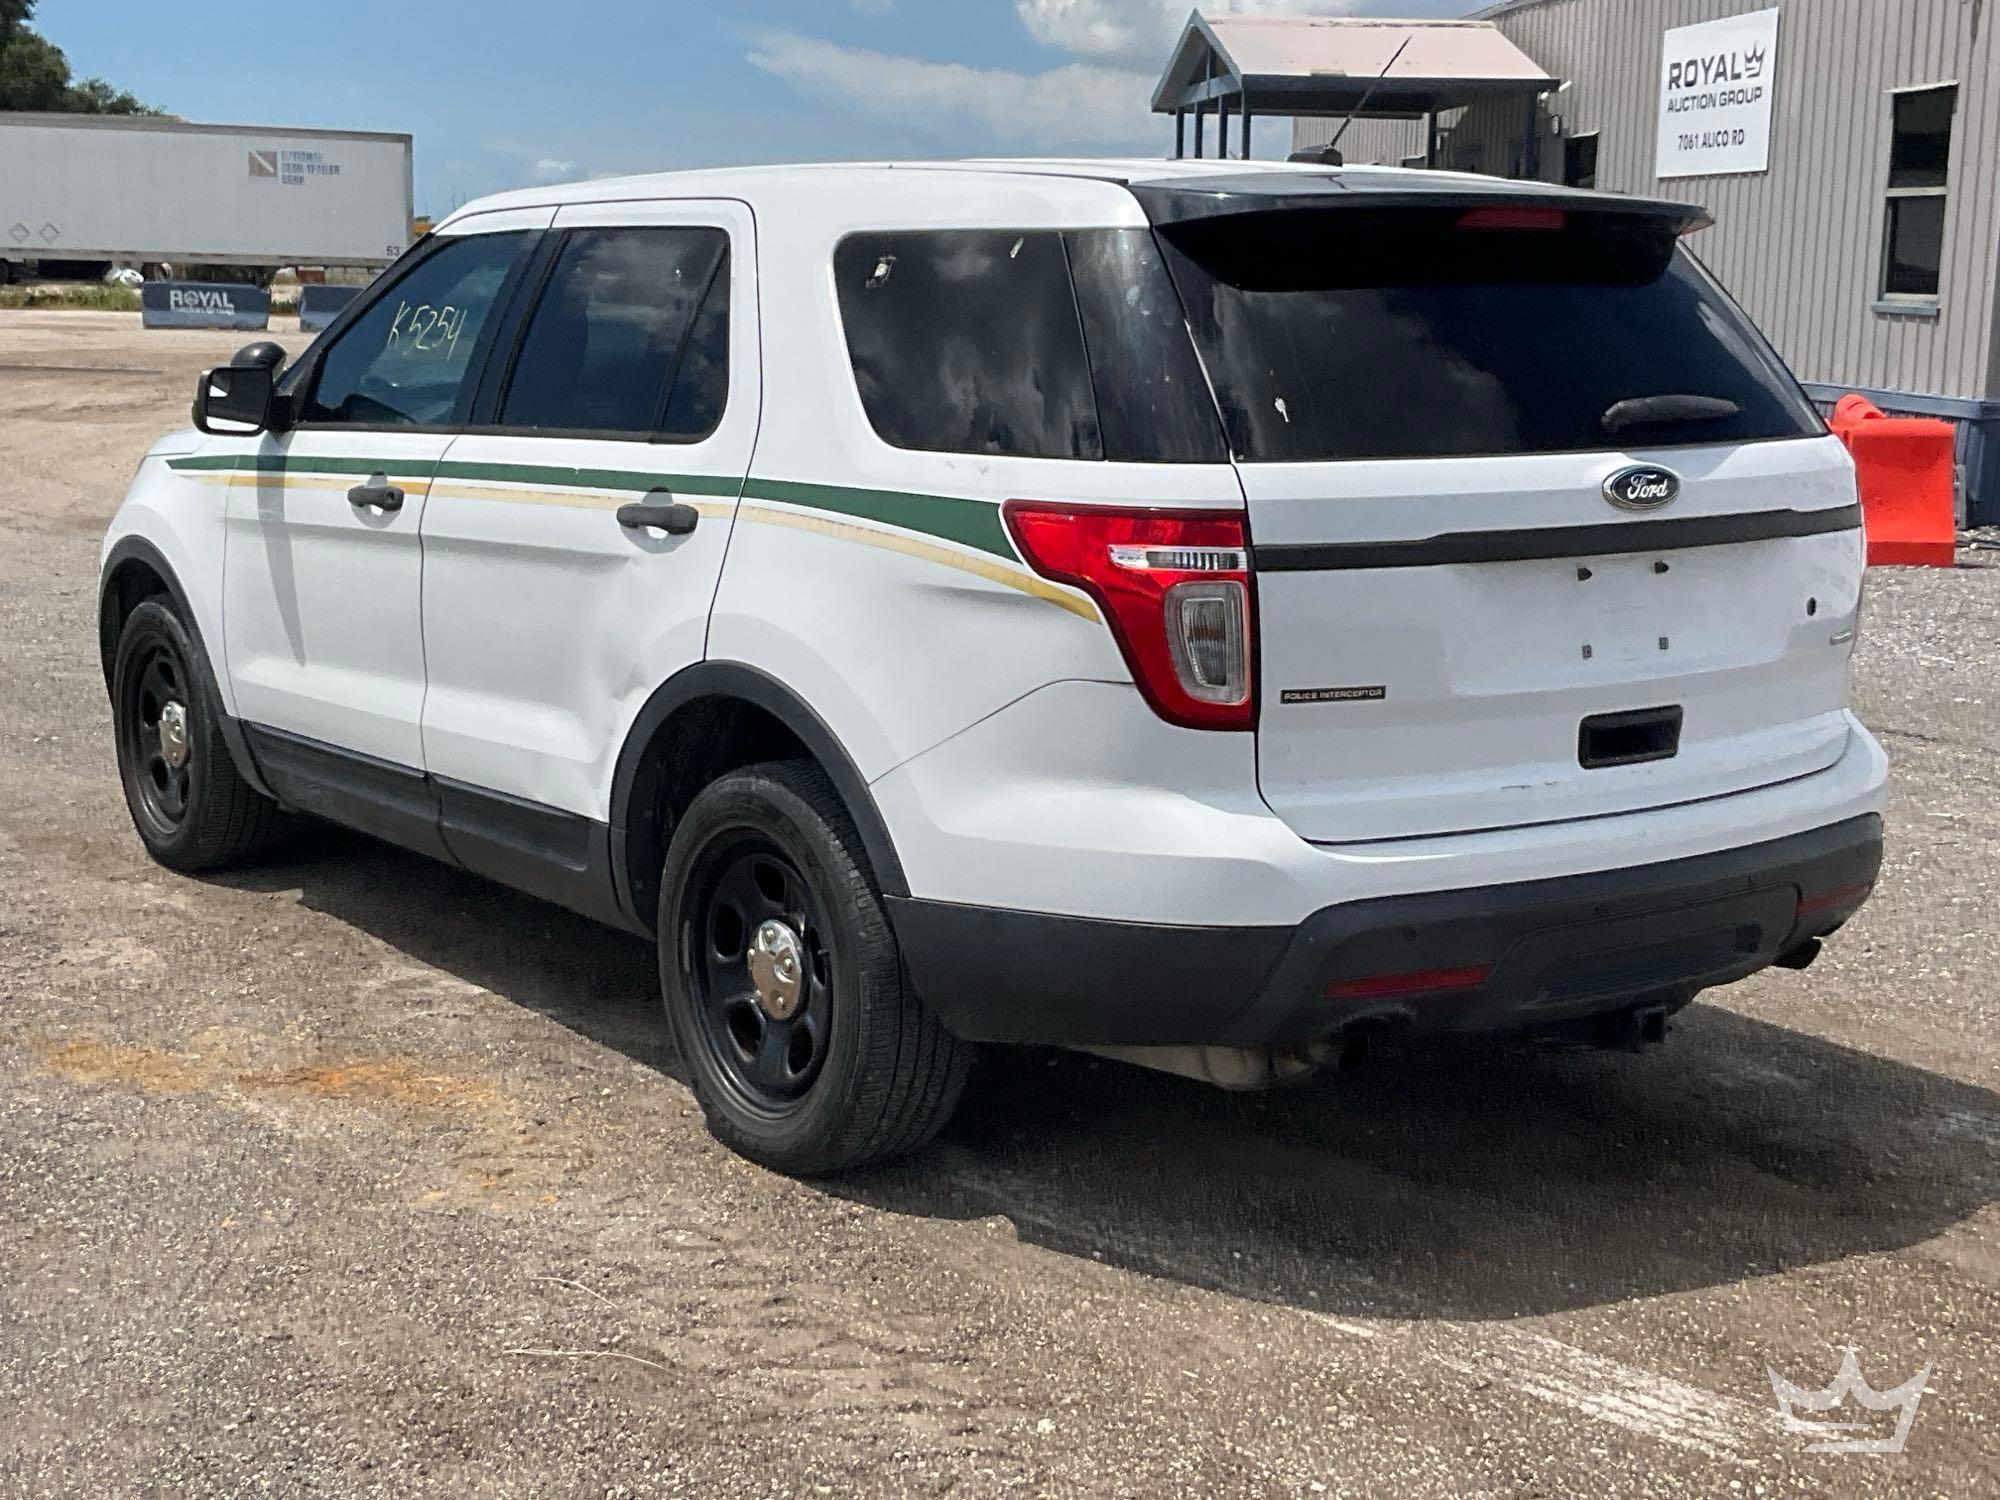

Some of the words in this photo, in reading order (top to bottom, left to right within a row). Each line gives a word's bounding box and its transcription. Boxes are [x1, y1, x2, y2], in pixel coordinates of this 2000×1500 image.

[1668, 52, 1742, 90] ROYAL
[1667, 93, 1717, 113] AUCTION
[1719, 86, 1763, 107] GROUP
[1678, 134, 1699, 151] 7061
[1701, 130, 1728, 149] ALICO
[1731, 129, 1745, 146] RD
[386, 245, 400, 257] 53
[170, 289, 234, 310] ROYAL
[387, 300, 467, 362] K5254
[1627, 473, 1668, 500] Ford
[1284, 691, 1317, 701] POLICE
[1319, 688, 1383, 699] INTERCEPTOR
